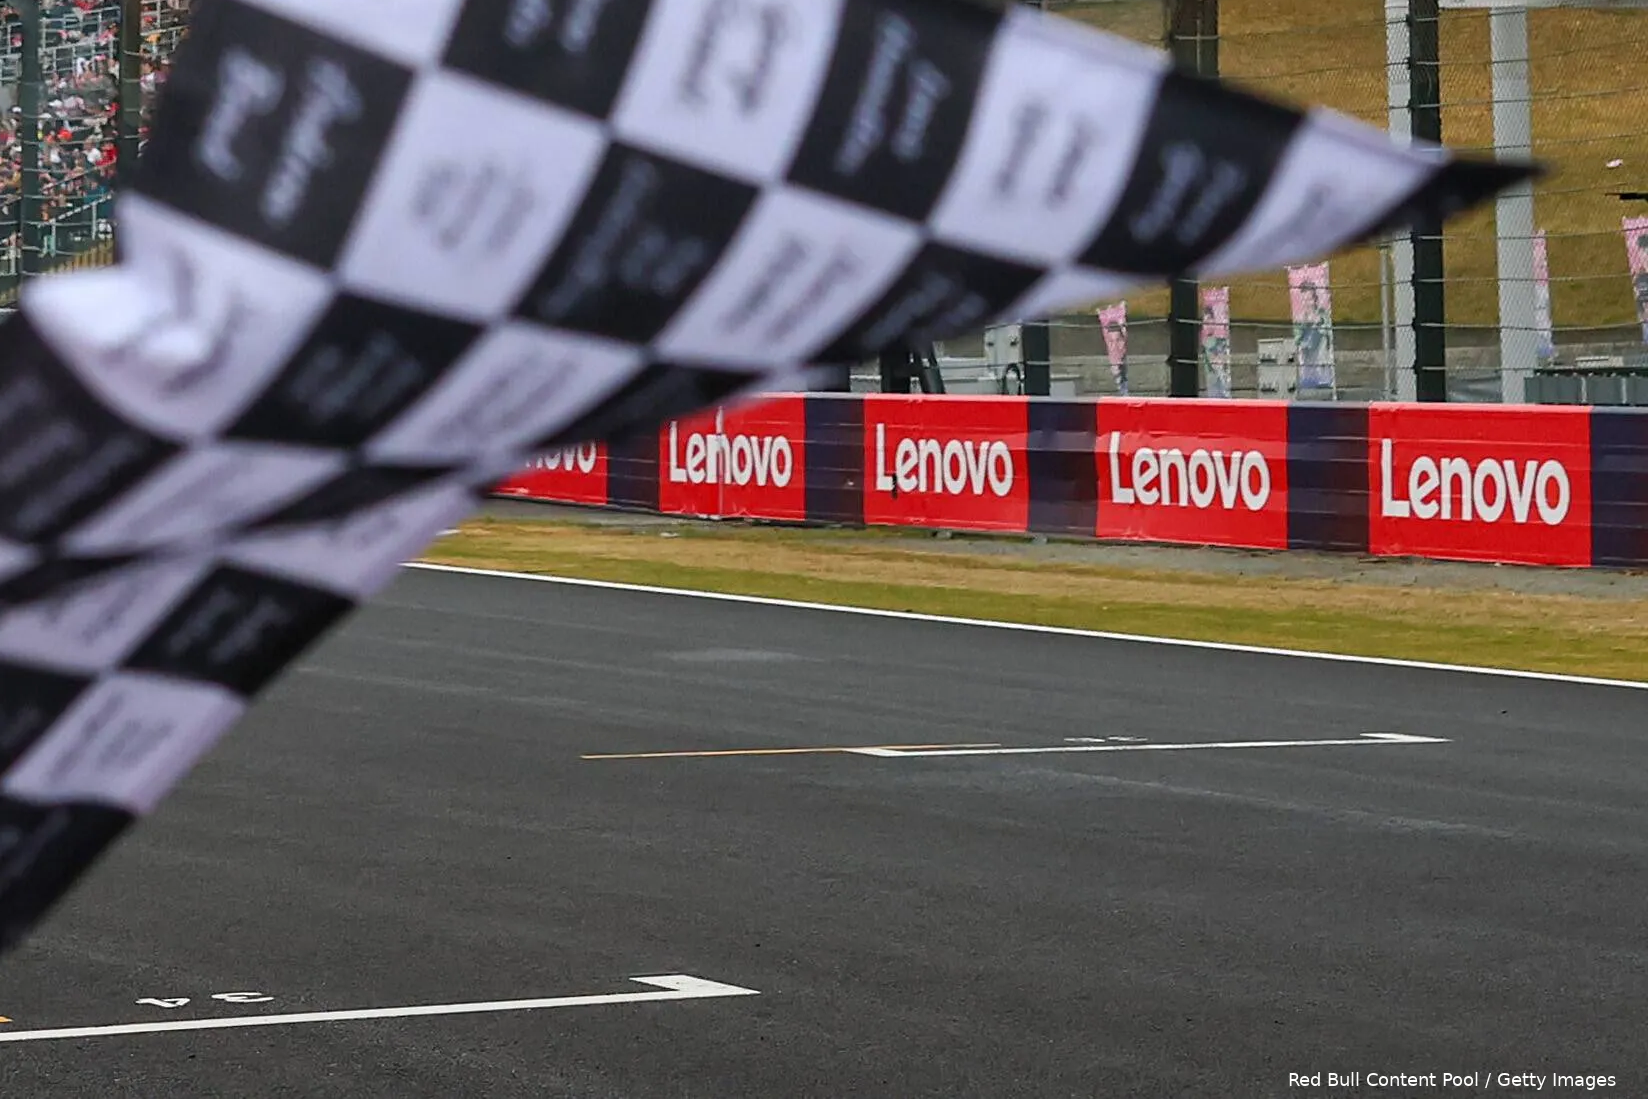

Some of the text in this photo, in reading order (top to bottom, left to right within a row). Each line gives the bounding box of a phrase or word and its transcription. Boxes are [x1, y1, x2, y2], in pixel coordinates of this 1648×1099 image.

[669, 420, 793, 487] Lenovo
[876, 423, 1013, 496] Lenovo
[1109, 431, 1271, 511] Lenovo
[1381, 438, 1571, 525] Lenovo
